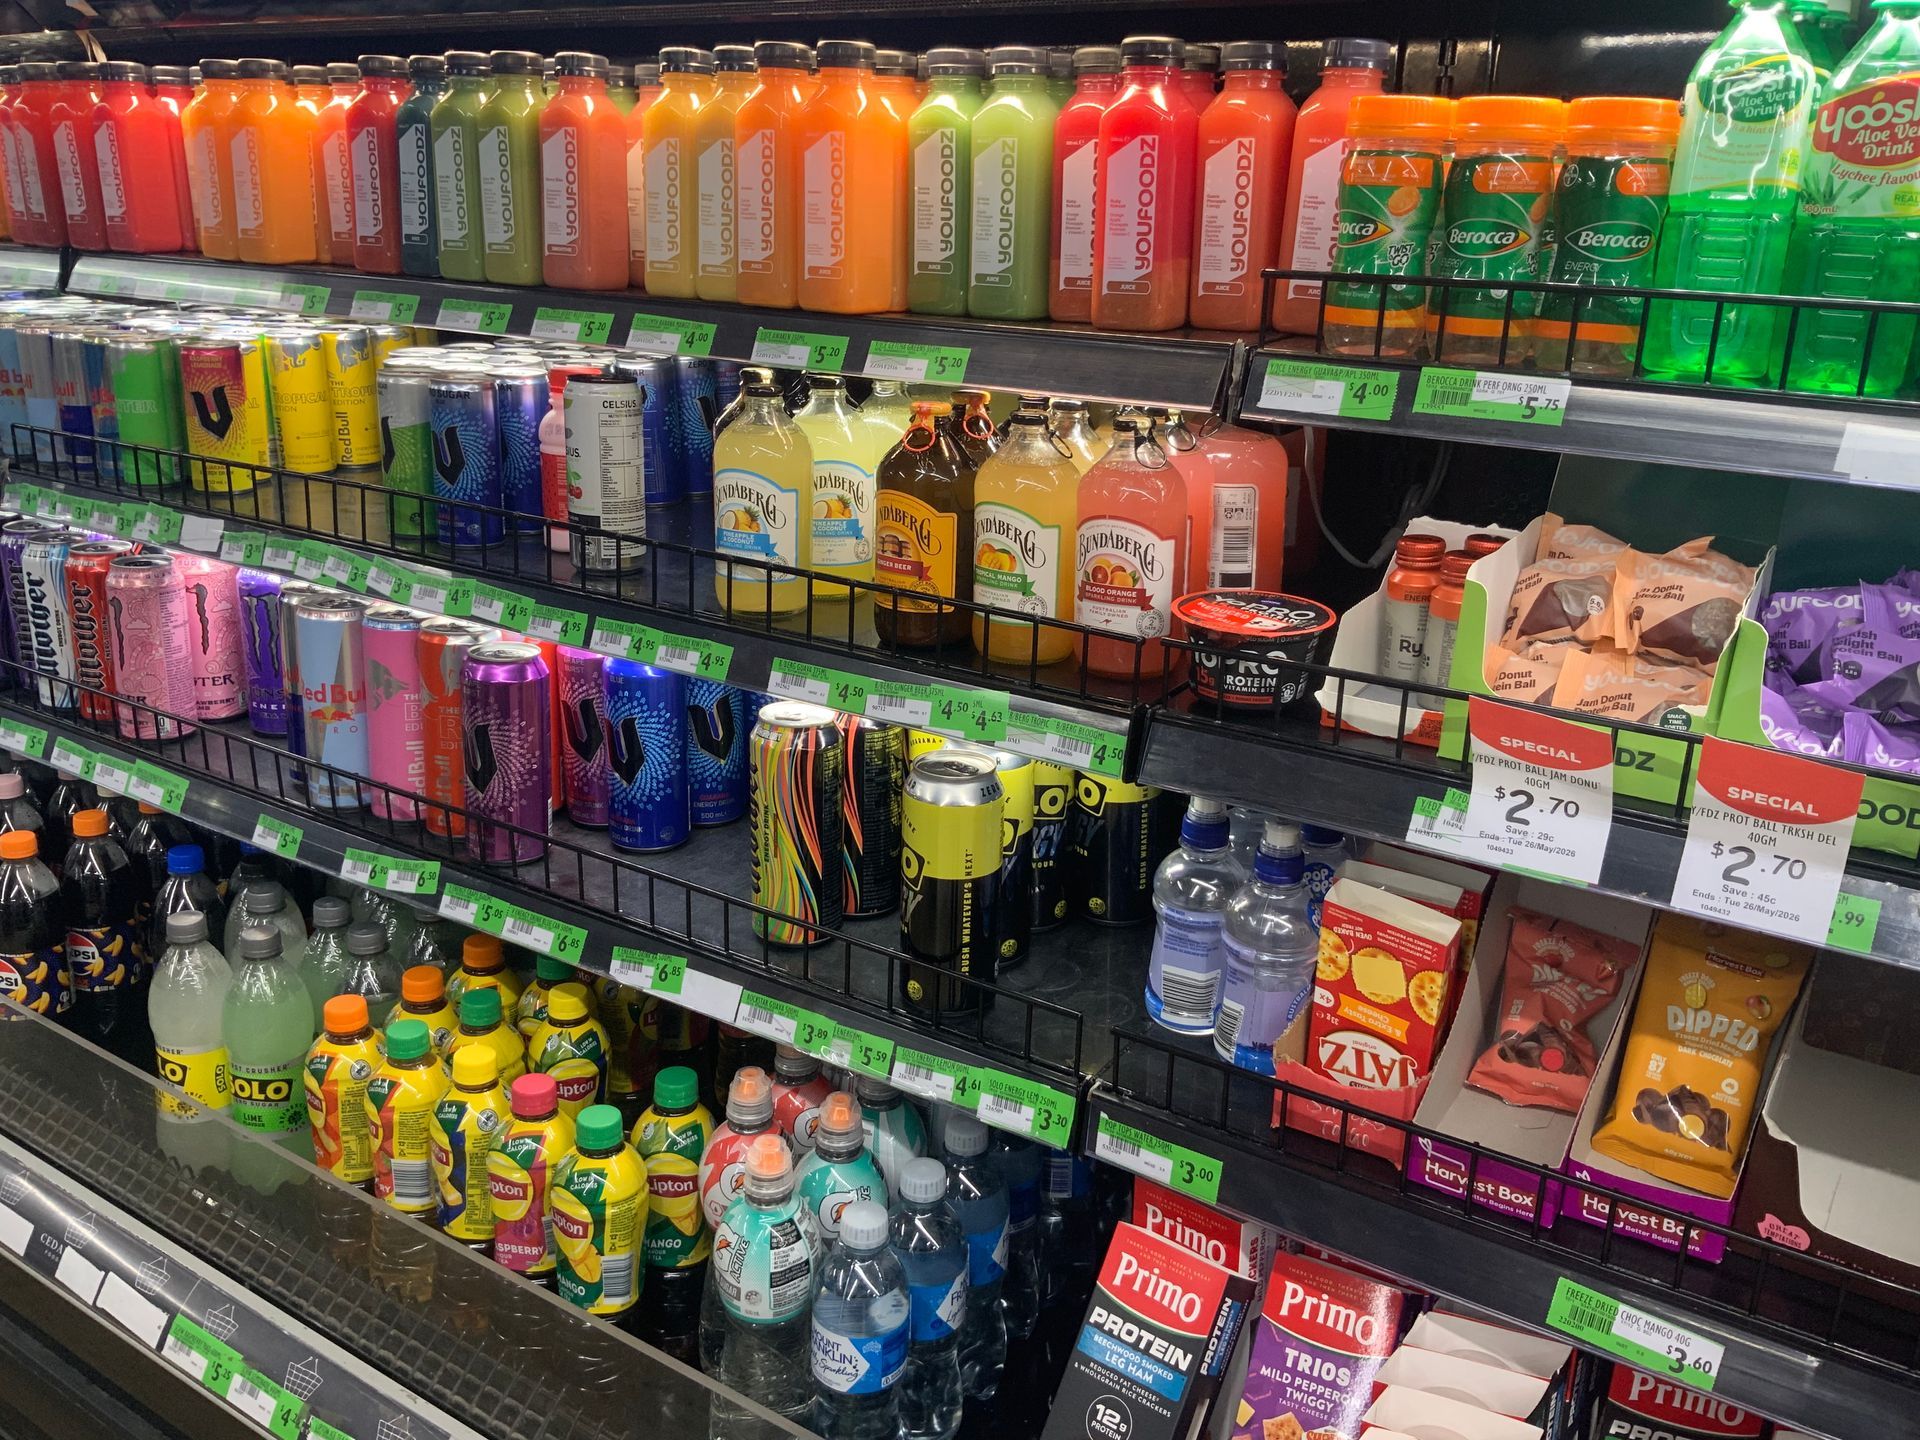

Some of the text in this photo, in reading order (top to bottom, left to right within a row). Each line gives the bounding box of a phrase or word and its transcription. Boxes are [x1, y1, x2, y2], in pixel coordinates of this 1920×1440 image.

[1766, 91, 1795, 103] Vera
[1848, 129, 1889, 145] Aloe
[1862, 140, 1914, 160] Drink
[366, 127, 381, 228] YOUFOODZ
[415, 125, 428, 226] YOUFOODZ
[564, 127, 578, 237] YOUFOODZ
[1831, 164, 1877, 183] Lychee
[760, 131, 774, 252] YOUFOODZ
[940, 130, 954, 252] YOUFOODZ
[998, 139, 1017, 265] YOUFOODZ
[1134, 137, 1157, 271] YOUFOODZ
[1230, 139, 1253, 272] YOUFOODZ
[1450, 228, 1516, 246] Berocca
[1577, 230, 1651, 249] Berocca
[584, 321, 607, 338] $5.20
[684, 330, 709, 349] $4.00
[814, 344, 840, 364] $5.20
[934, 356, 962, 375] $5.20
[1348, 381, 1389, 405] $4.00
[1426, 375, 1458, 387] BEROCCA
[1459, 377, 1482, 388] DRINK
[1483, 380, 1500, 391] PERF
[1524, 383, 1547, 395] 250ML
[602, 400, 637, 409] CELSIUS
[1519, 395, 1560, 420] $5.75
[336, 412, 354, 463] Red Bull
[723, 531, 754, 540] PINEAPPLE
[727, 537, 755, 545] COCONUT
[1076, 529, 1164, 582] BUNDABERG
[894, 562, 912, 571] BEER
[997, 574, 1022, 583] MANGO
[1085, 584, 1138, 598] BLOOD ORANGE
[1116, 596, 1138, 604] DRINK
[631, 635, 656, 655] $4.95
[1789, 639, 1811, 650] Ball
[700, 650, 725, 671] $4.95
[1877, 651, 1903, 664] Ball
[609, 674, 625, 685] BLUE
[1224, 675, 1276, 687] ROTEIN
[1498, 670, 1533, 682] Donut
[1514, 679, 1536, 690] Ball
[835, 682, 864, 703] $4.50
[1224, 684, 1258, 693] VITAMIN
[938, 699, 969, 721] $4.50
[1576, 693, 1633, 707] Jam Donut
[1611, 702, 1635, 713] Ball
[971, 710, 1003, 731] $4.63
[1009, 712, 1030, 723] B/BERG
[1055, 721, 1078, 733] B/BERG
[1094, 743, 1123, 765] 4.50
[1499, 736, 1582, 764] SPECIAL
[1498, 759, 1567, 782] PROT BALL JAM
[1524, 776, 1550, 790] 40GM
[1494, 785, 1580, 826] $2.70
[1727, 786, 1819, 817] SPECIAL
[1505, 825, 1554, 843] Save 29c
[1722, 812, 1837, 846] PROT BALL TRKSH DEL
[1747, 831, 1777, 847] 40GM
[1479, 831, 1576, 858] Ends Tue 26/May/2026
[1711, 840, 1807, 886] $2.70
[1692, 888, 1801, 922] Ends Tue 26/May/2026
[1721, 884, 1777, 905] Save 45c
[962, 881, 973, 946] WHATEVER'S
[556, 932, 580, 952] $6.85
[1707, 954, 1744, 970] Harvest
[655, 963, 681, 983] $6.85
[802, 1023, 828, 1044] $3.89
[1666, 1004, 1760, 1051] DIPPED
[859, 1045, 888, 1066] $5.59
[915, 1052, 935, 1065] ENERGY
[1320, 1036, 1418, 1088] JATZ
[215, 1064, 227, 1094] SOLO
[988, 1079, 1026, 1096] SOLO ENERGY
[243, 1112, 263, 1123] LIME
[1037, 1107, 1068, 1131] $3.30
[1180, 1160, 1214, 1184] $3.00
[1498, 1186, 1534, 1207] Box
[1145, 1202, 1227, 1265] Primo
[1625, 1225, 1679, 1246] Better Begins
[1764, 1227, 1802, 1248] TEMPTATIONS
[730, 1237, 751, 1284] ACTIVE
[1112, 1251, 1202, 1323] Primo
[1279, 1280, 1379, 1346] Primo
[1566, 1288, 1692, 1348] FREEZE DRIED CHOC MANGO 40G
[1089, 1306, 1193, 1371] PROTEIN
[1199, 1297, 1232, 1376] PROTEIN
[1093, 1333, 1174, 1382] BEECHWOOD SMOKED
[1105, 1350, 1154, 1384] LEG HAM
[1285, 1347, 1351, 1387] TRIOS
[1666, 1344, 1713, 1374] $3.60
[818, 1358, 858, 1383] Sparkling
[1089, 1361, 1132, 1388] REDUCED FAT
[1260, 1365, 1292, 1384] MILD
[1080, 1364, 1172, 1418] WHOLEGRAIN RICE CRACKERS
[1285, 1387, 1335, 1413] TWIGGY
[1278, 1398, 1299, 1410] TASTY
